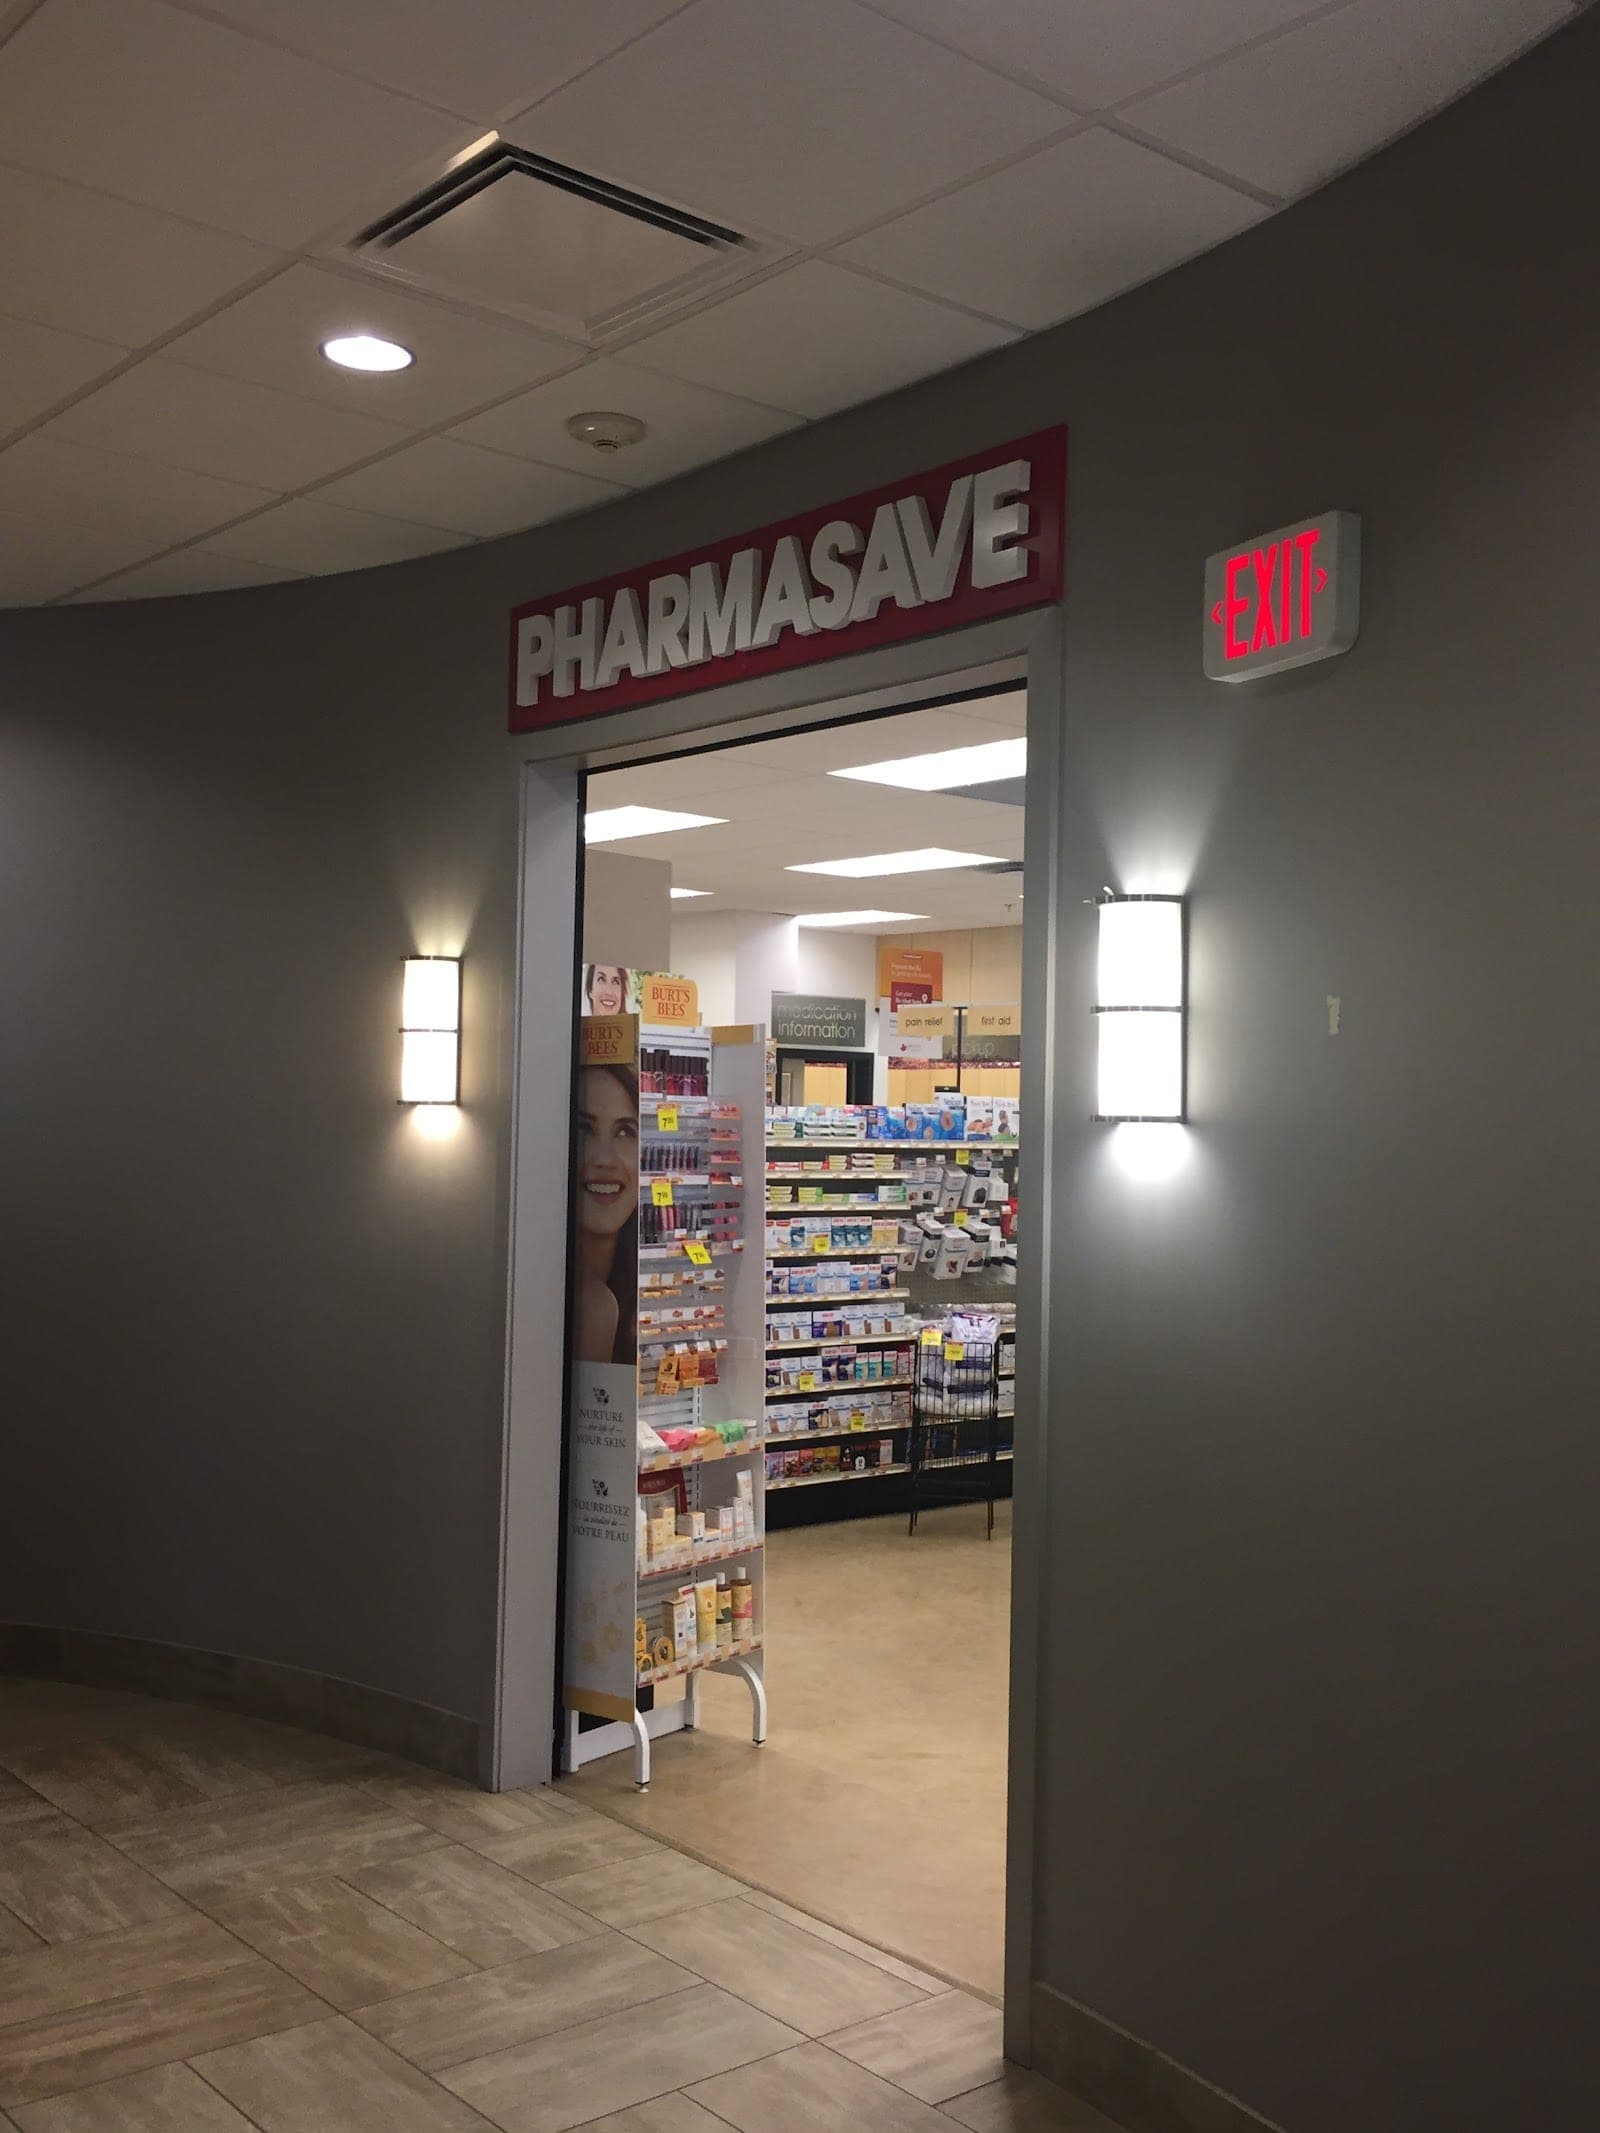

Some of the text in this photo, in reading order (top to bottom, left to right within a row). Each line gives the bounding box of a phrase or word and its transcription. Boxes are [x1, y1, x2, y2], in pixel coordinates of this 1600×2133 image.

[517, 459, 1031, 707] PHARMASAVE
[1225, 528, 1320, 661] EXIT
[652, 986, 690, 1003] BURT'S
[658, 1002, 686, 1016] BEES
[776, 1003, 857, 1021] medication
[905, 1017, 921, 1028] pain
[924, 1016, 944, 1026] relief
[981, 1016, 1011, 1025] first aid
[778, 1021, 856, 1039] information
[578, 1408, 624, 1422] NURTURE
[603, 1436, 627, 1448] SKIN
